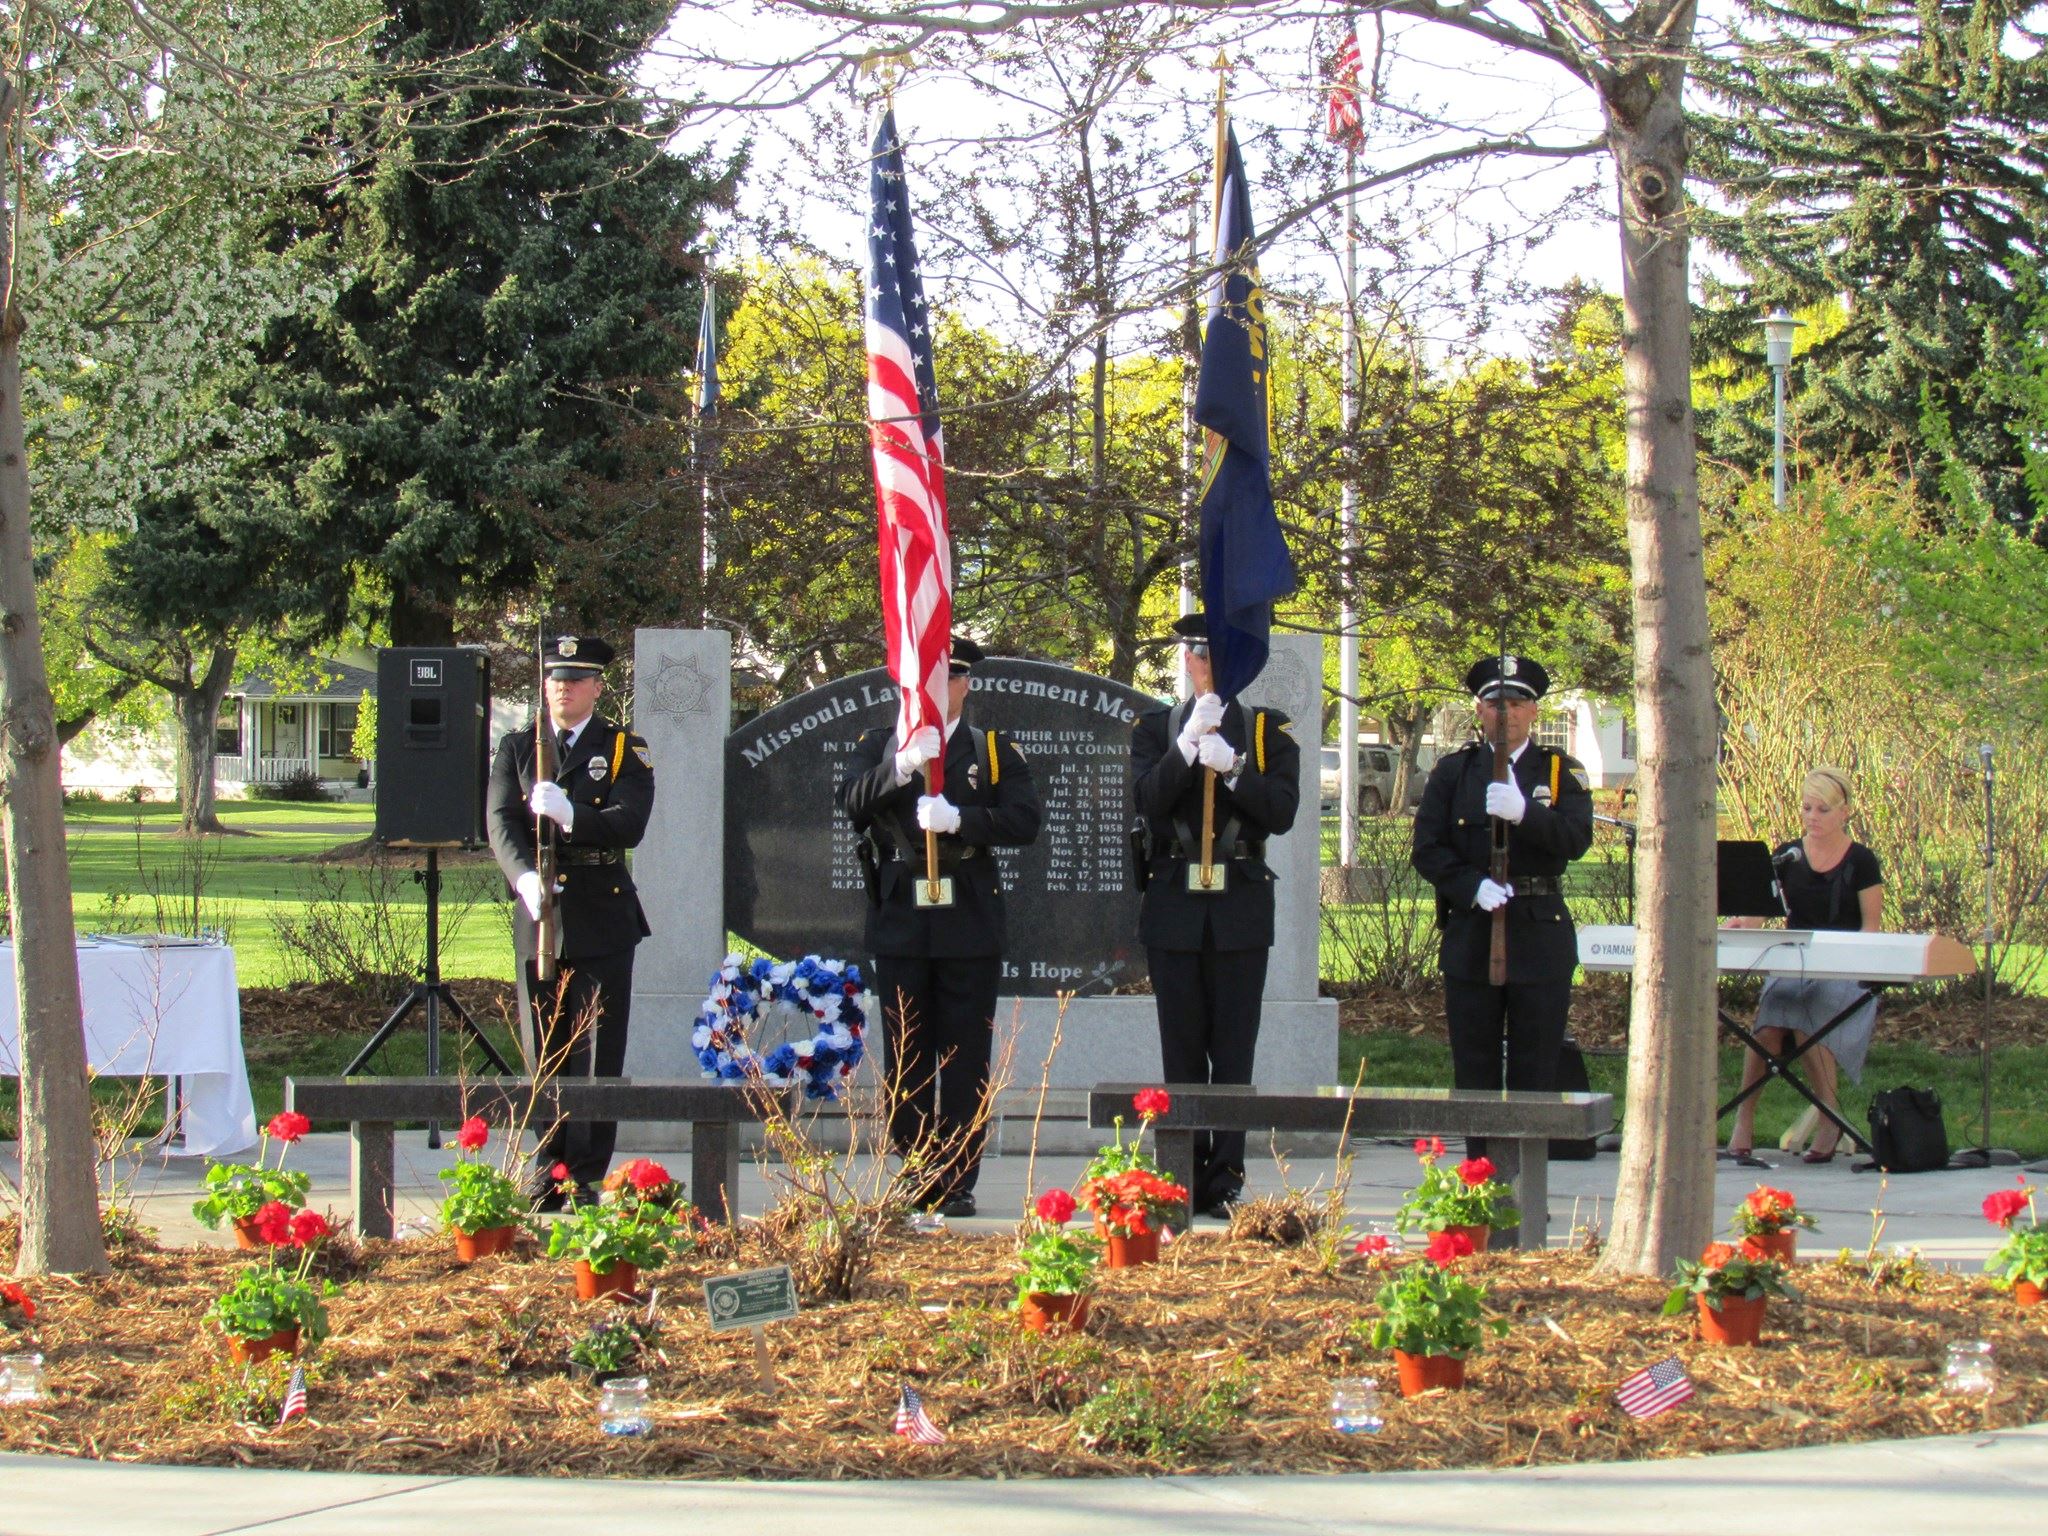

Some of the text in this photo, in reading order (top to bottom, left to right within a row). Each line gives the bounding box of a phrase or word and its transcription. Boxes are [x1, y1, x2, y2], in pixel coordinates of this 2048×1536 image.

[416, 666, 437, 679] JBL
[741, 697, 858, 768] Missoula
[968, 676, 1090, 707] orcement
[1093, 691, 1135, 723] Me
[1014, 730, 1052, 742] THEIR
[1059, 730, 1094, 742] LIVES
[823, 741, 839, 752] IN
[1075, 743, 1131, 755] COUNTY
[1060, 764, 1079, 774] Jul.
[1084, 764, 1094, 775] 1,
[1099, 764, 1124, 773] 1878
[1049, 775, 1072, 785] Feb.
[1078, 776, 1093, 786] 14,
[1099, 776, 1123, 785] 1904
[1053, 787, 1123, 798] Jul. 21, 1933
[1045, 800, 1123, 810] Mar. 26, 1934
[1049, 812, 1074, 821] Mar.
[1080, 812, 1095, 822] 11,
[1100, 812, 1124, 821] 1941
[1044, 823, 1070, 834] Aug.
[1075, 824, 1093, 834] 20,
[1099, 824, 1123, 833] 1958
[1050, 835, 1072, 845] Jan.
[1077, 836, 1094, 846] 27,
[1099, 835, 1123, 845] 1976
[1052, 847, 1076, 856] Nov.
[1082, 847, 1093, 857] 5,
[1098, 847, 1123, 856] 1982
[1051, 859, 1076, 868] Dec.
[1081, 859, 1093, 869] 6,
[1098, 859, 1122, 869] 1984
[1046, 870, 1072, 880] Mar.
[1077, 870, 1093, 880] 17,
[1099, 870, 1123, 880] 1931
[832, 880, 866, 890] M.P.D
[1047, 882, 1070, 891] Feb.
[1076, 882, 1092, 892] 12,
[1098, 882, 1123, 891] 2010
[1001, 961, 1083, 982] Is Hope
